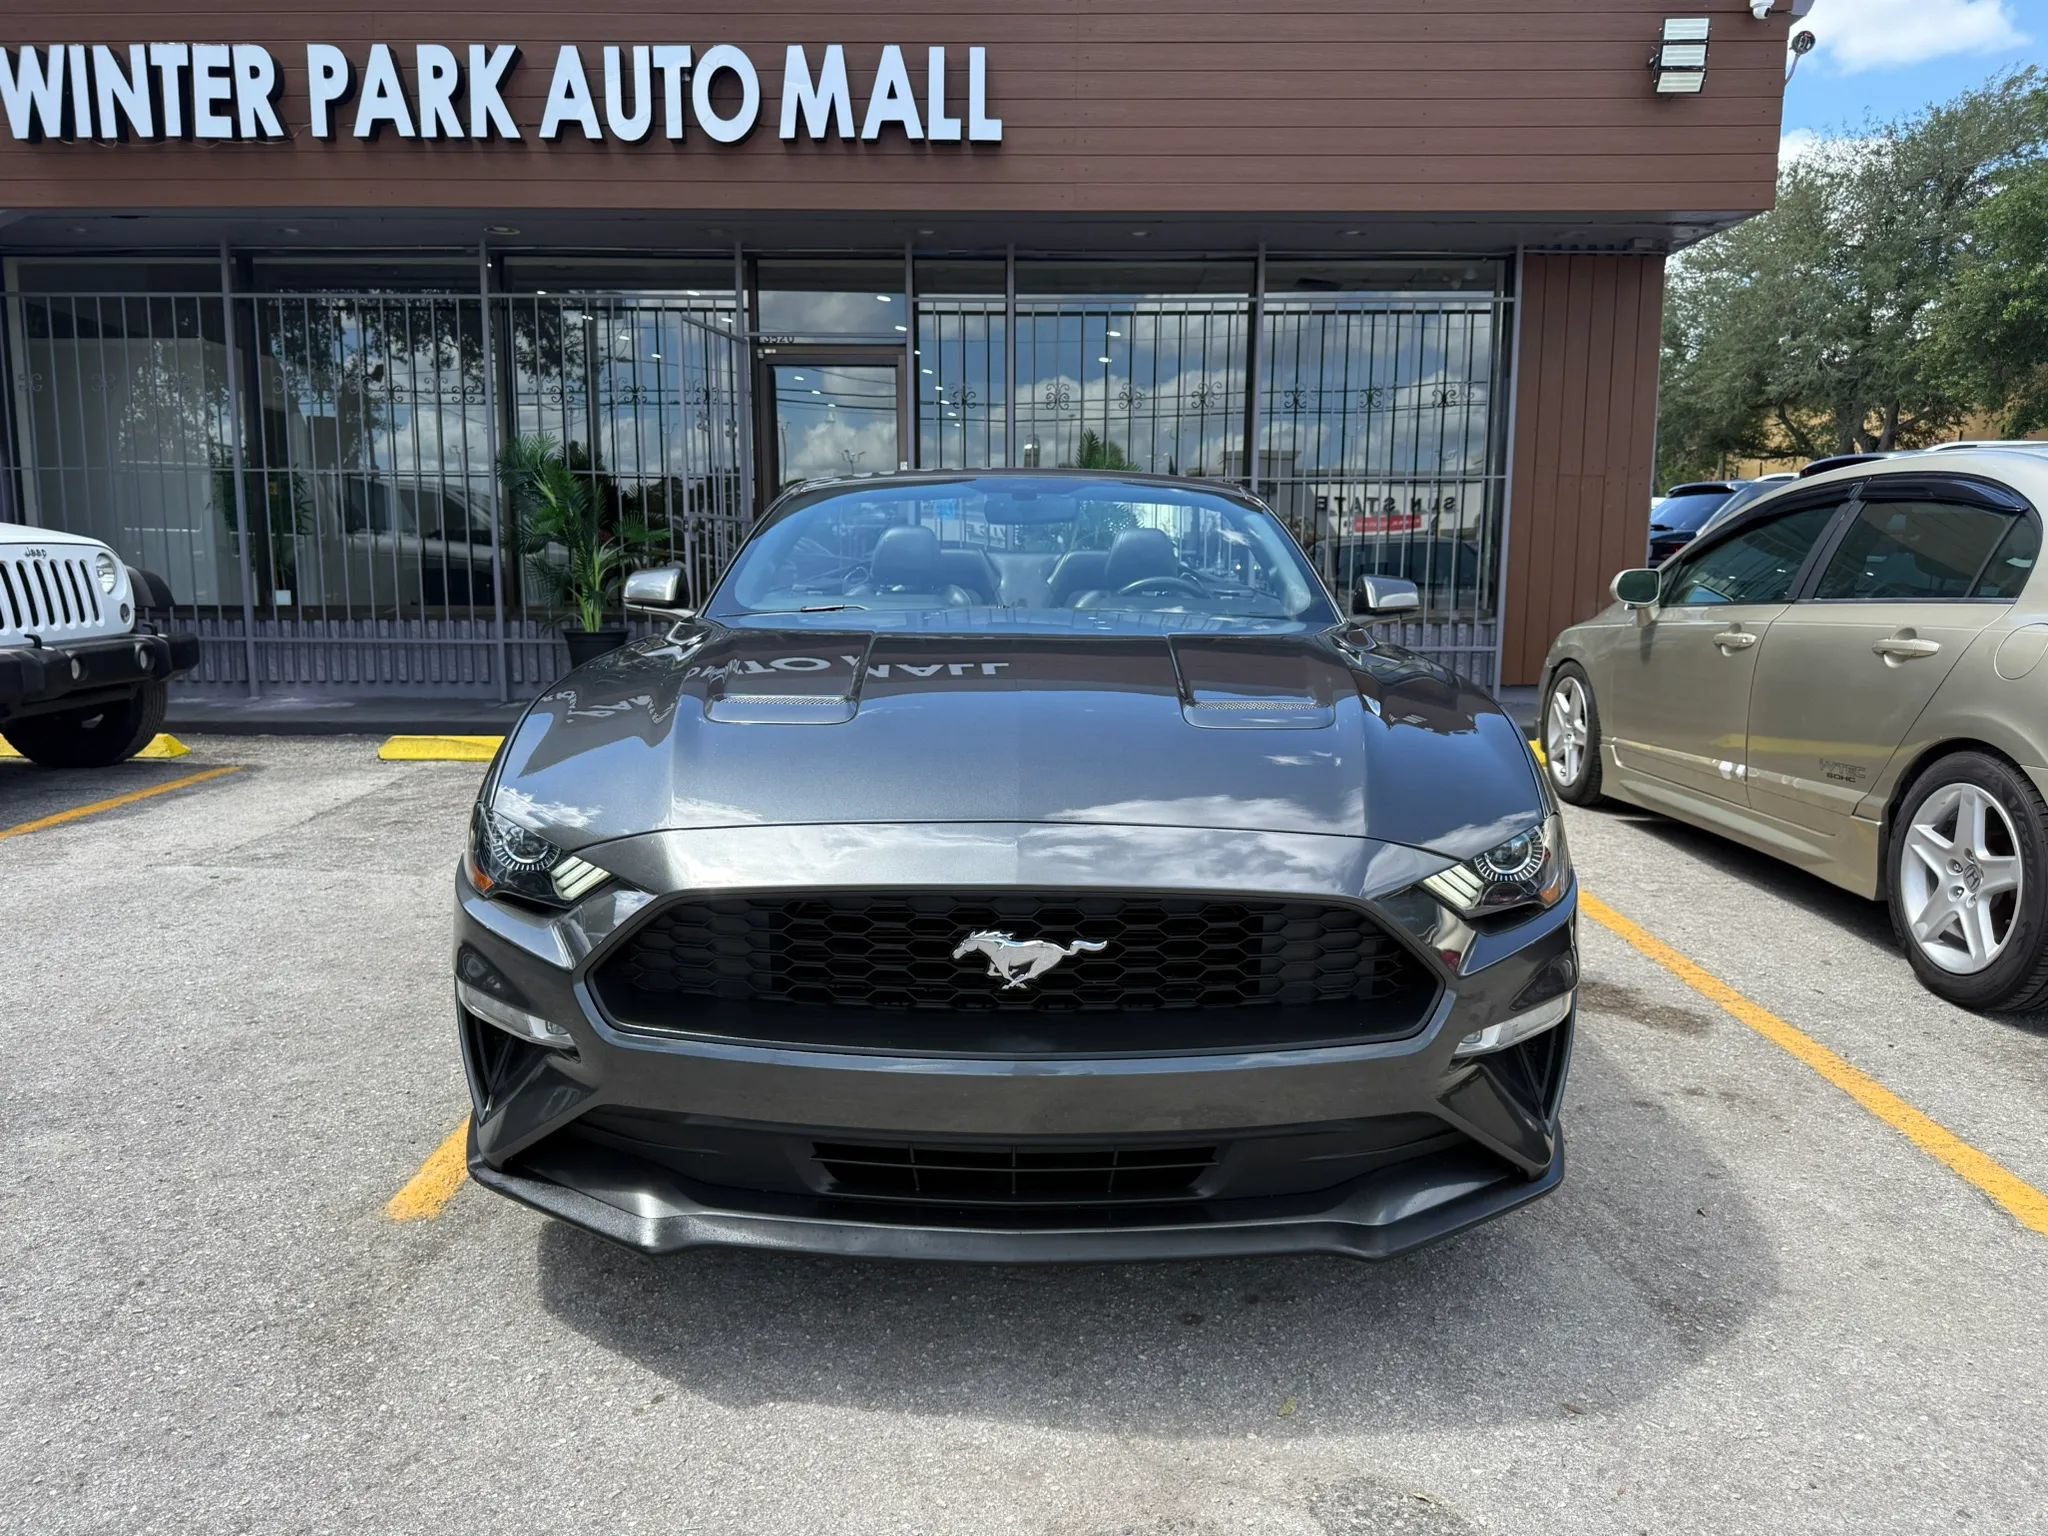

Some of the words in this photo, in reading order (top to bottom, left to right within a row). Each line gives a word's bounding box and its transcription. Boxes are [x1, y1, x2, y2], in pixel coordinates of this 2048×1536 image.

[0, 43, 285, 139] WINTER
[306, 43, 521, 138] PARK
[539, 44, 760, 143] AUTO
[779, 44, 1002, 141] MALL
[25, 546, 47, 559] Jeep
